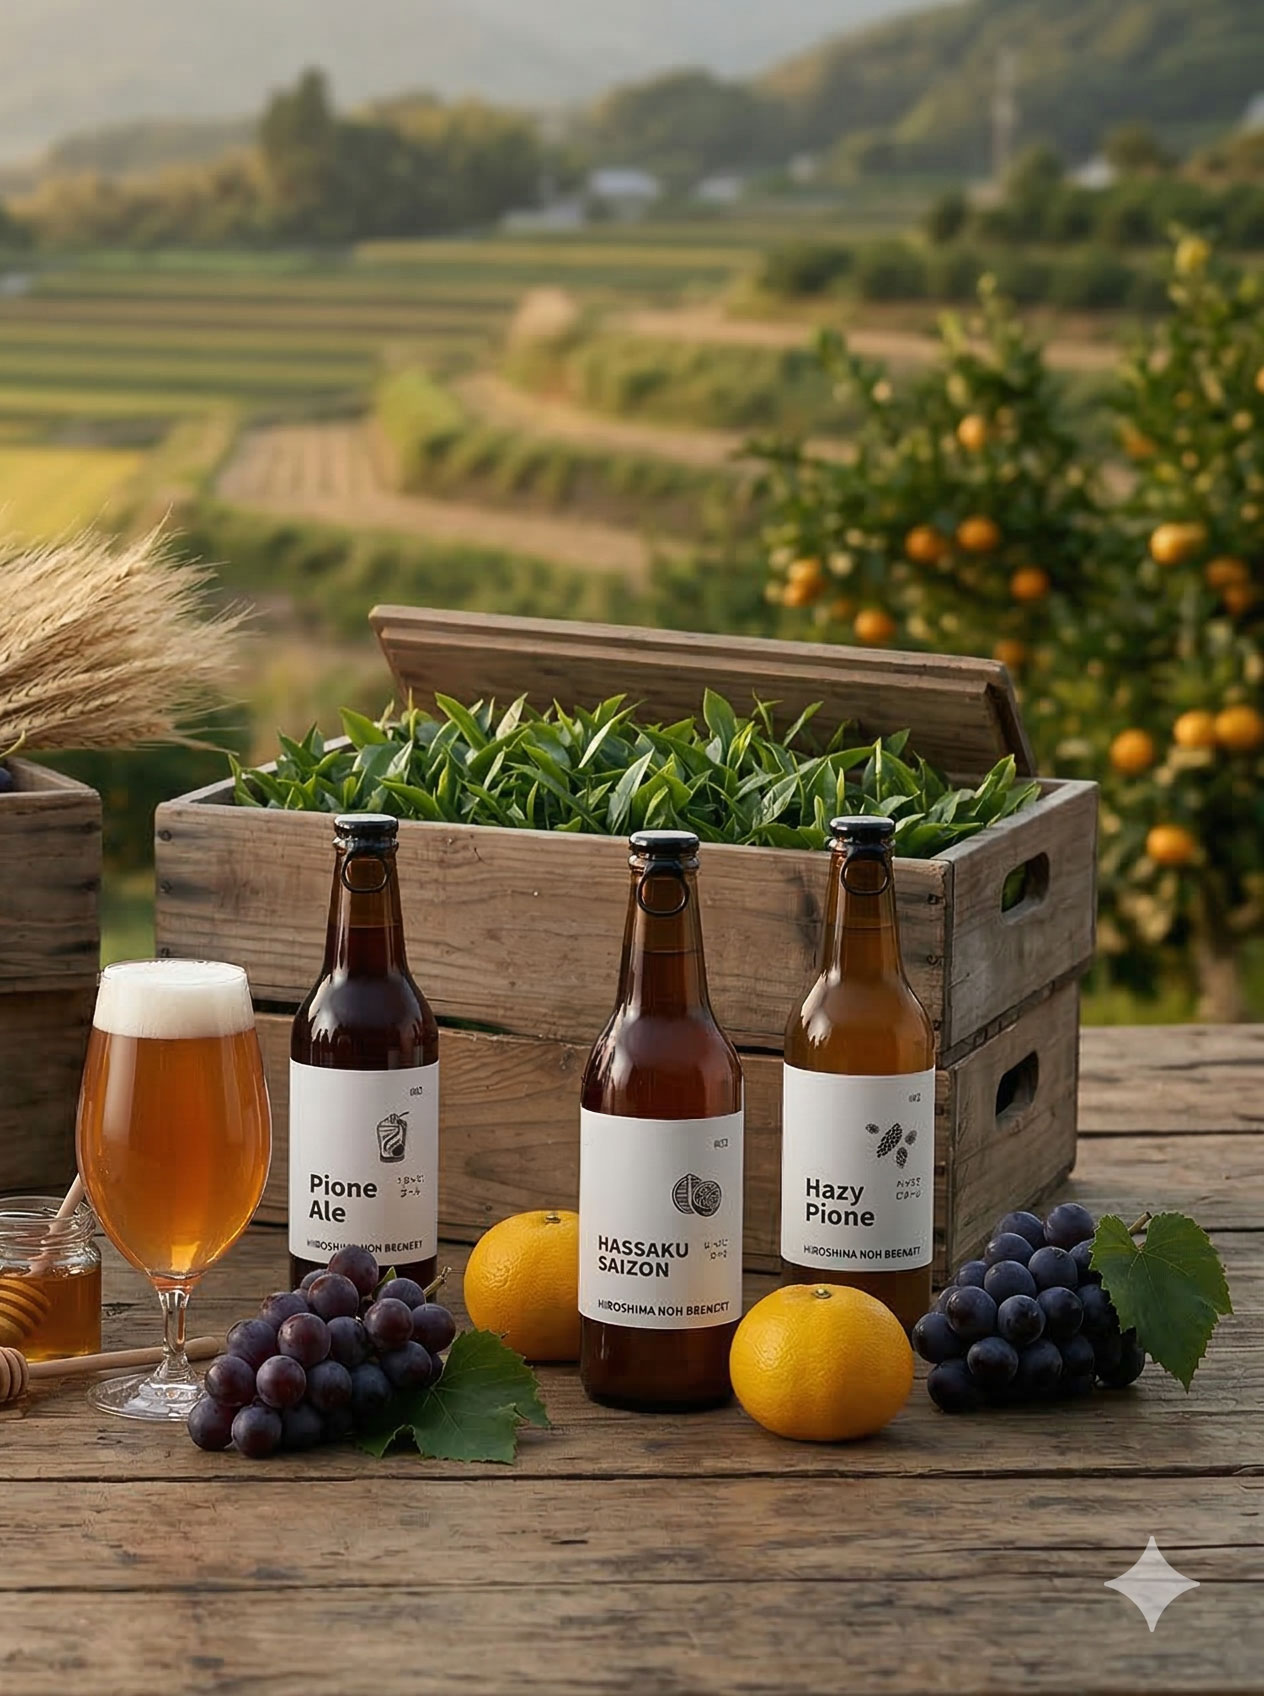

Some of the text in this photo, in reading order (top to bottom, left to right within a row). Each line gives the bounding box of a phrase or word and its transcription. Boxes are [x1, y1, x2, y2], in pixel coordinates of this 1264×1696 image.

[309, 1173, 378, 1199] Pione
[805, 1177, 864, 1206] Hazy
[308, 1200, 346, 1223] Ale
[805, 1202, 875, 1227] Pione
[598, 1235, 689, 1259] HASSAKU
[860, 1250, 882, 1260] NOH
[598, 1256, 670, 1278] SAIZON
[597, 1299, 656, 1317] HIROSHIMA
[657, 1305, 683, 1317] NOH
